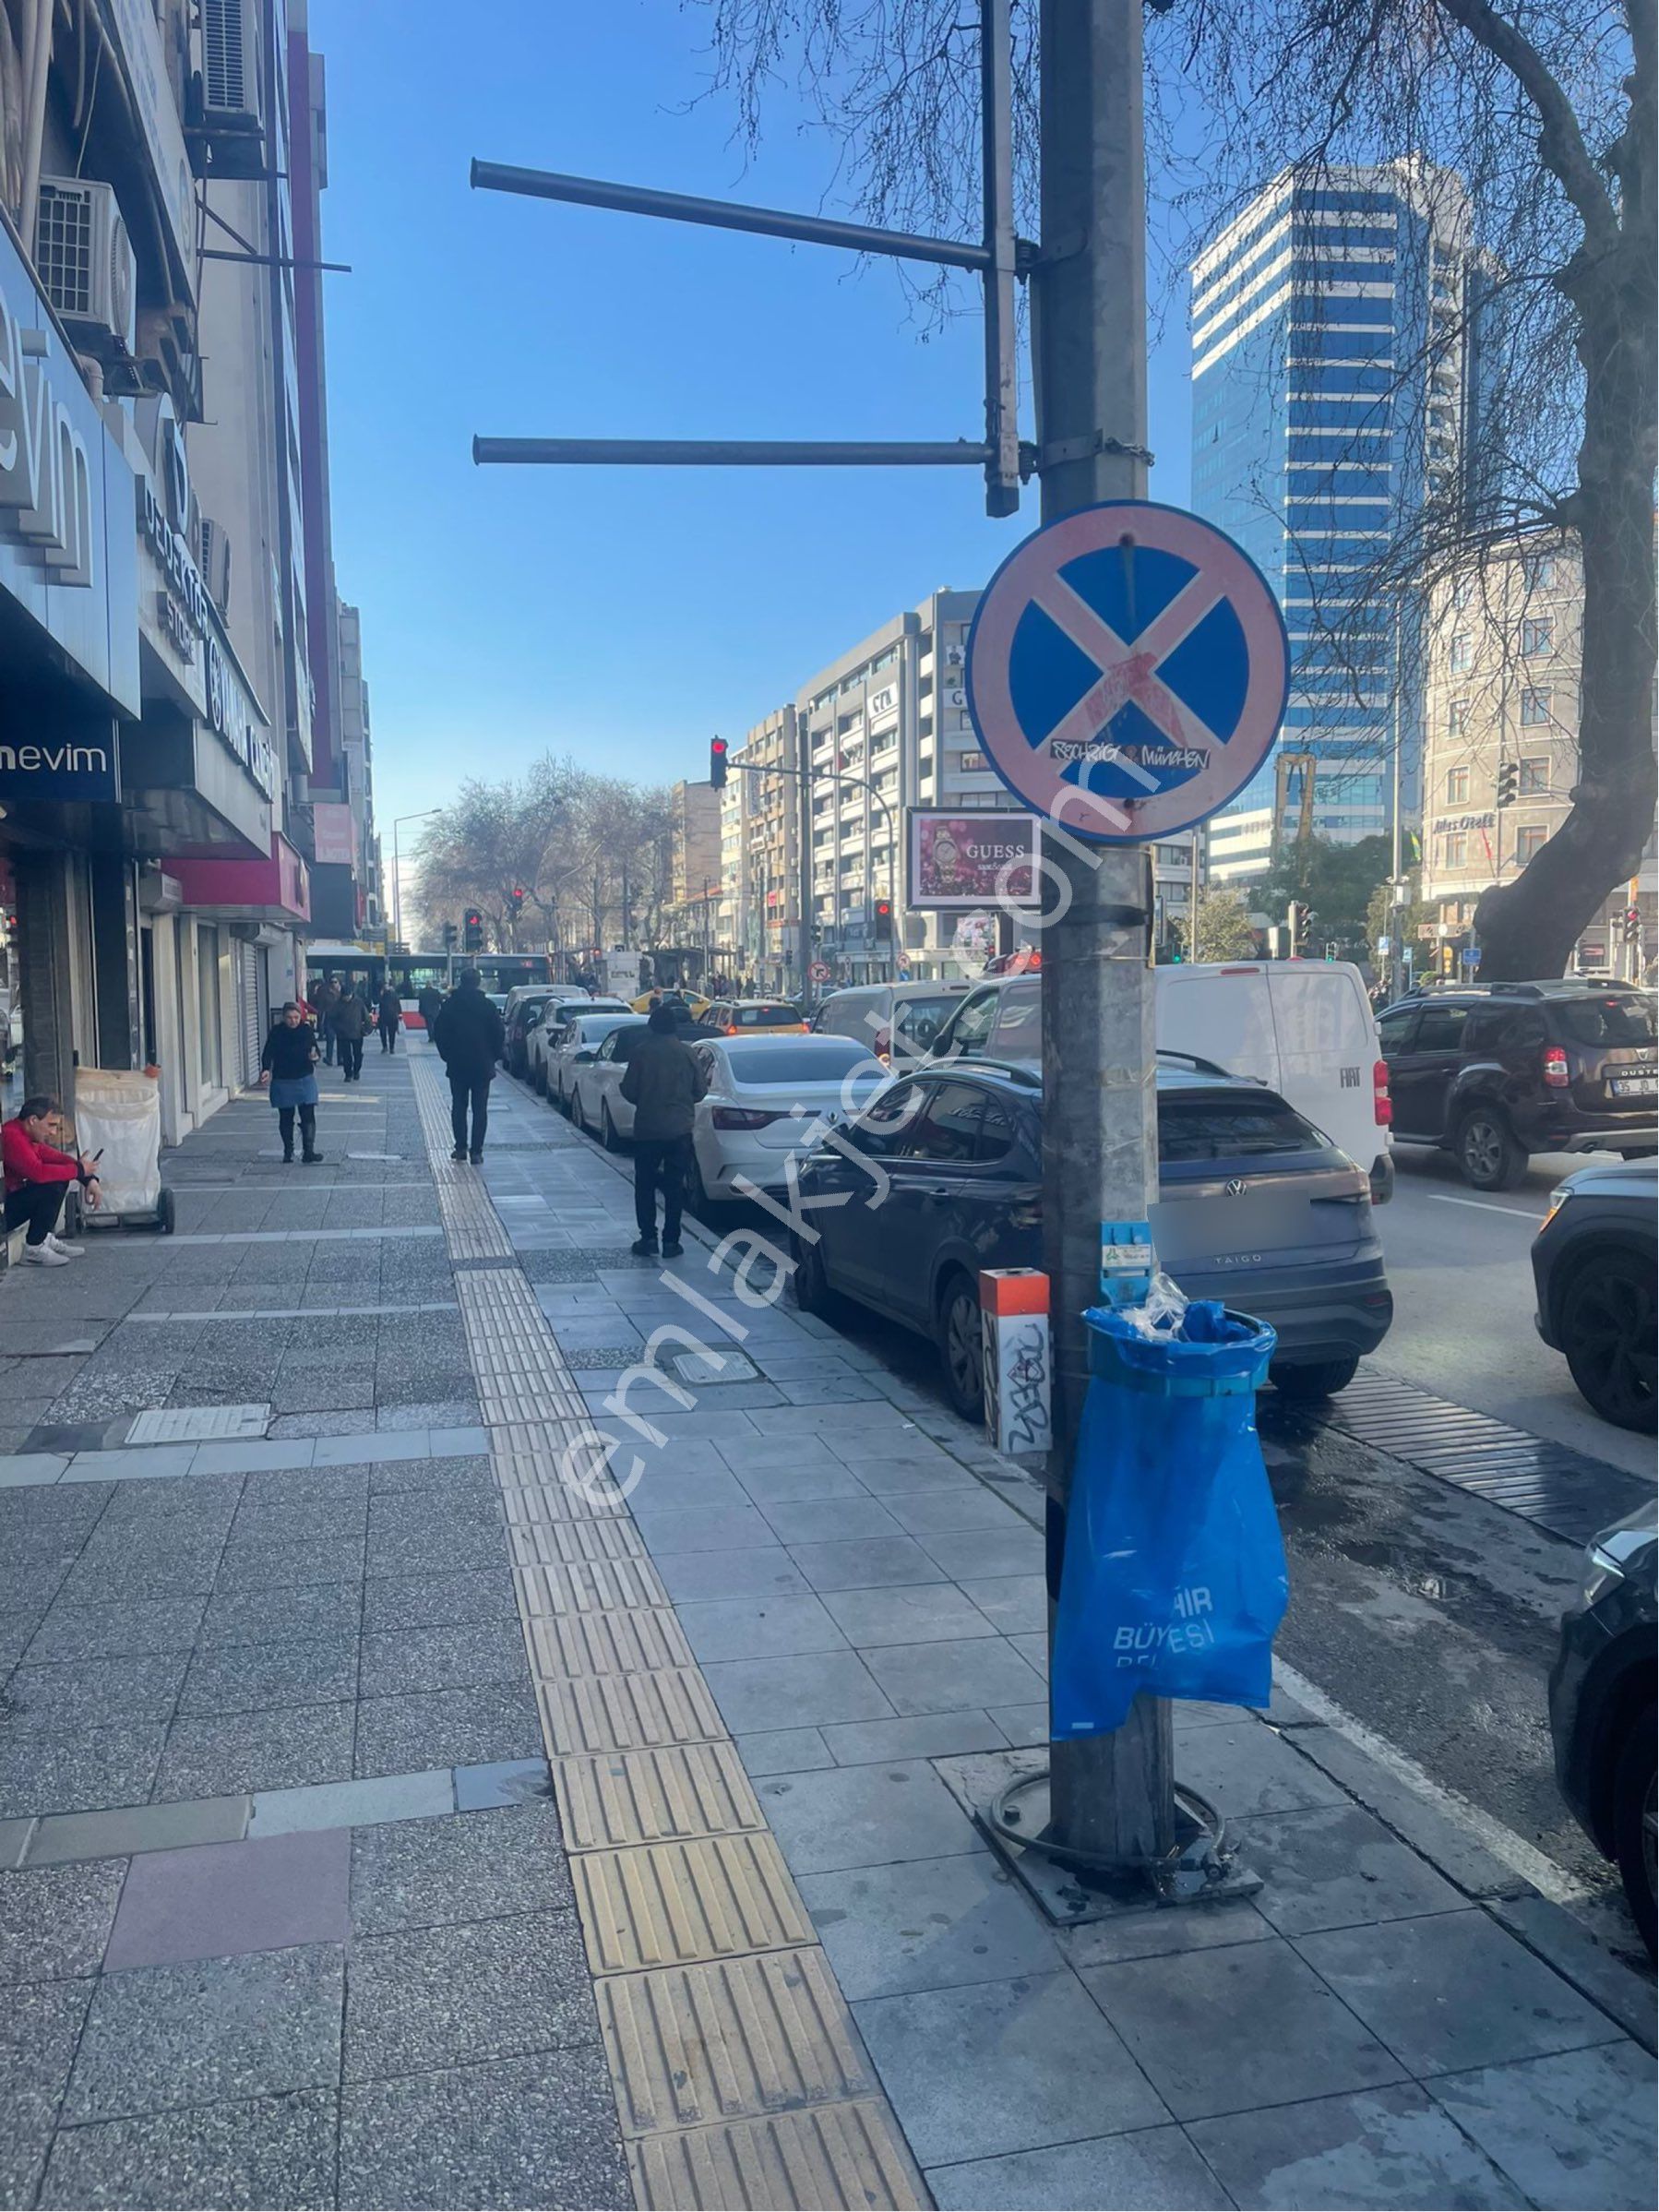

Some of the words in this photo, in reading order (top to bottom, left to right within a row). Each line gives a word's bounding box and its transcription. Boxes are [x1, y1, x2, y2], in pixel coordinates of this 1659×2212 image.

[966, 844, 1025, 858] GUESS
[1340, 1066, 1360, 1089] FIAT
[1215, 1254, 1261, 1264] TAIGO
